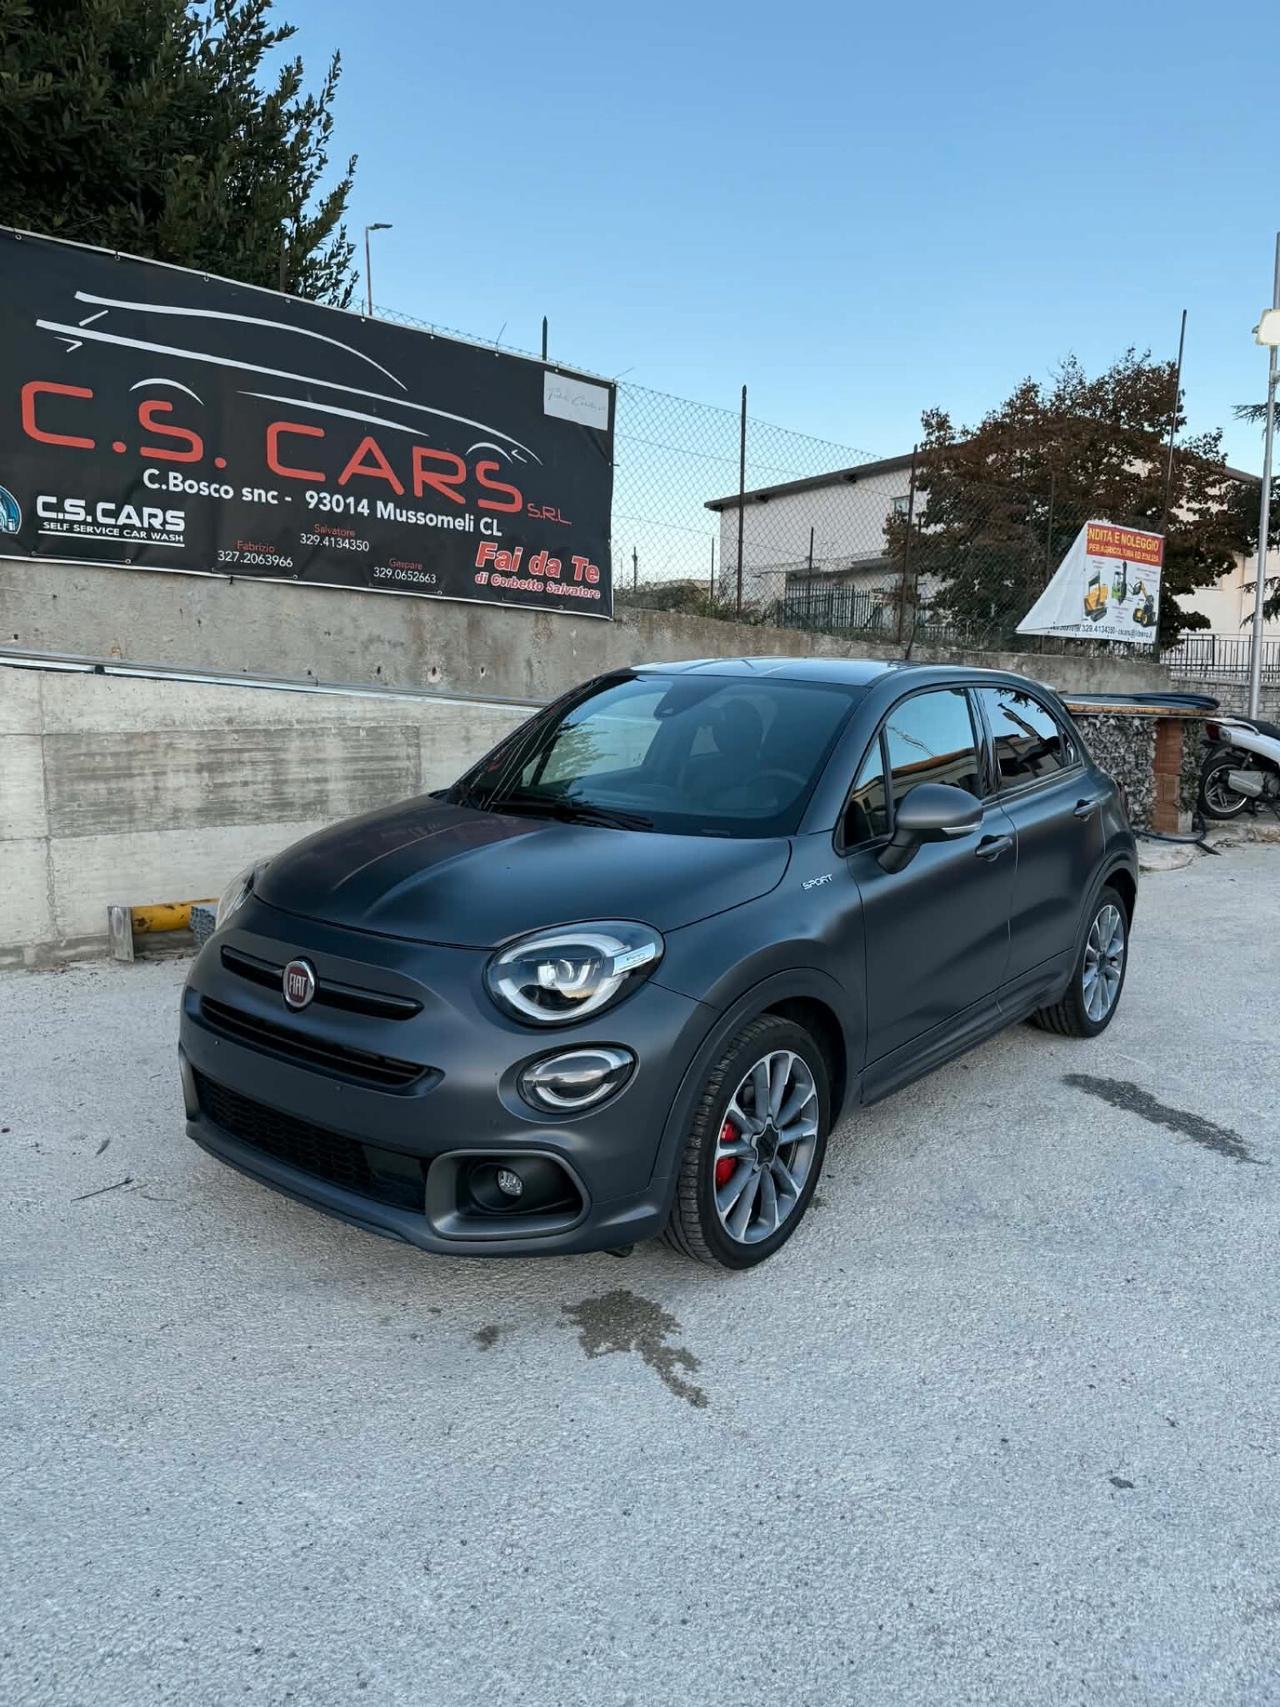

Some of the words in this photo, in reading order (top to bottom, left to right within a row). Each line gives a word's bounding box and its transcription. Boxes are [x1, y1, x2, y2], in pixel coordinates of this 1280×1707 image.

[266, 421, 523, 513] CARS
[143, 468, 234, 500] C.Bosco
[241, 486, 279, 505] snc
[305, 491, 369, 517] 93014
[376, 500, 474, 532] Mussomeli
[479, 517, 503, 536] CL
[43, 521, 70, 531] SELF
[73, 524, 120, 536] SERVICE
[123, 529, 148, 539] CAR
[151, 532, 184, 542] WASH
[314, 523, 356, 537] Salvatore
[236, 539, 275, 553] Fabrizio
[300, 533, 370, 552] 329.4134350
[1114, 531, 1120, 544] E
[1121, 532, 1159, 551] NOLEGGIO
[217, 550, 294, 568] 327.2063966
[475, 541, 524, 572] Fai
[528, 550, 562, 579] da
[571, 555, 600, 584] Te
[373, 566, 437, 584] 329.0652663
[474, 571, 489, 585] di
[490, 573, 544, 592] Corbetto
[546, 580, 601, 599] Salvatore
[802, 873, 833, 890] SPORT
[289, 973, 307, 997] FIAT
